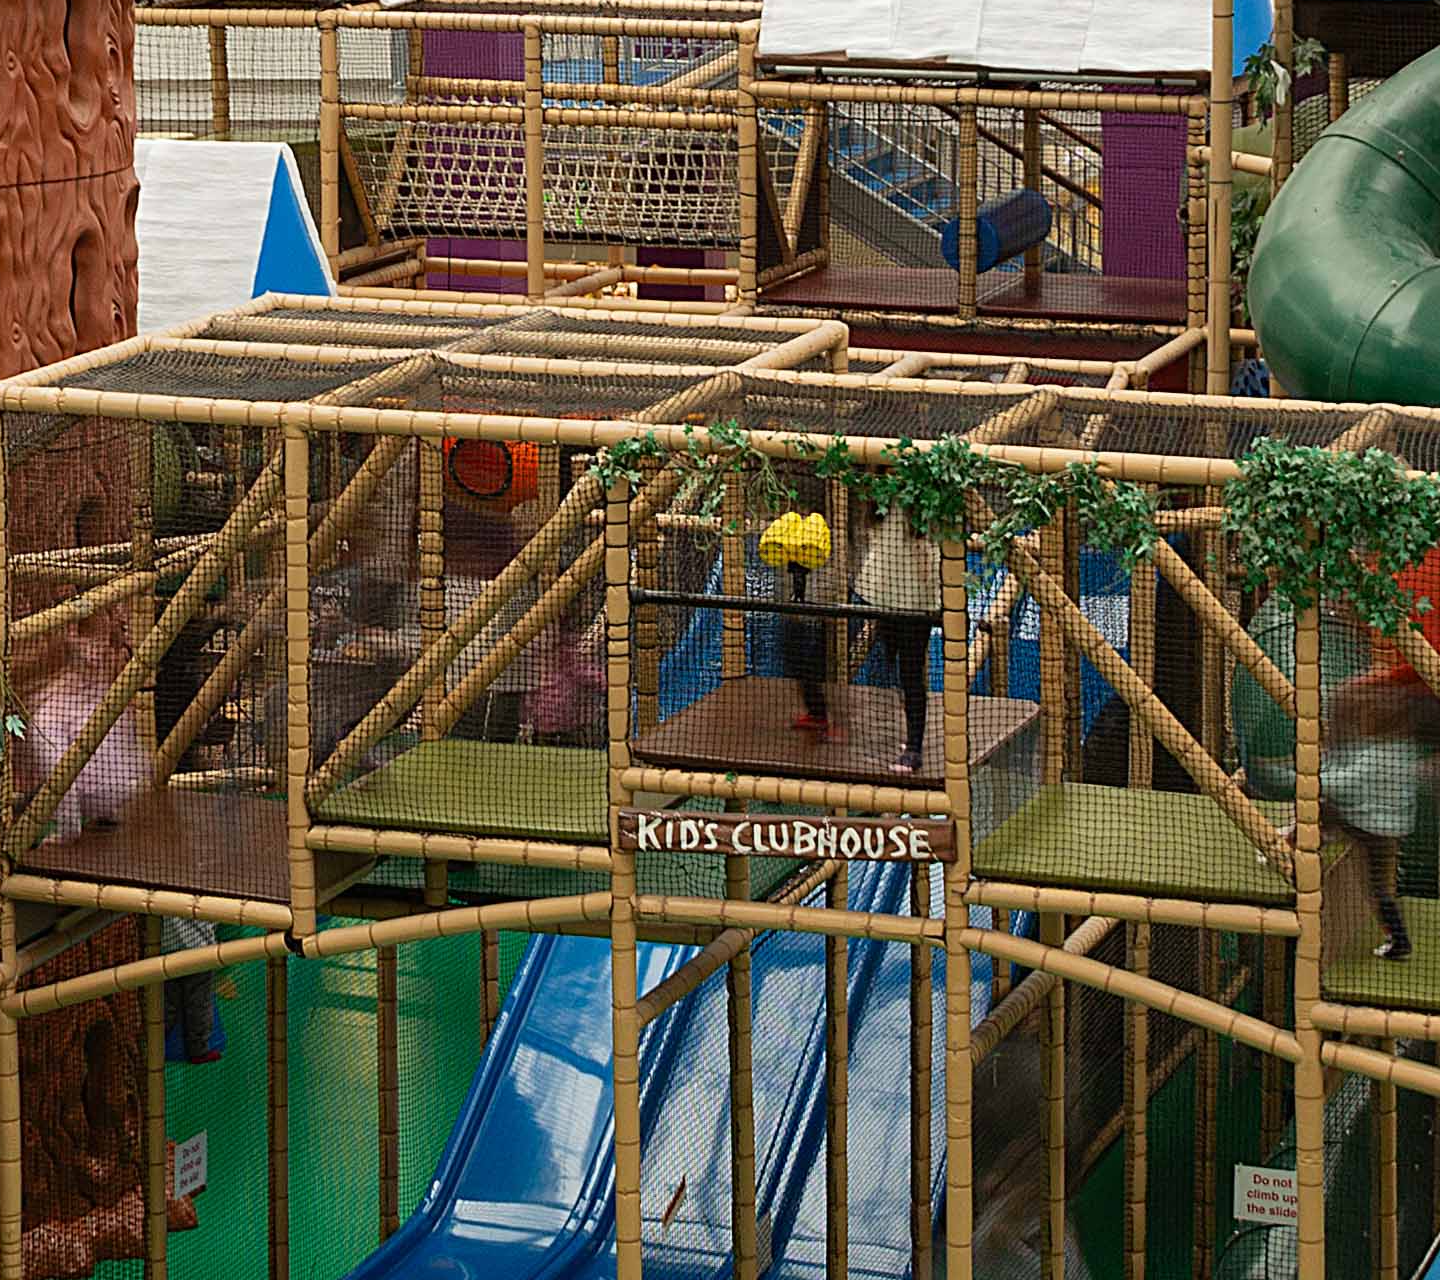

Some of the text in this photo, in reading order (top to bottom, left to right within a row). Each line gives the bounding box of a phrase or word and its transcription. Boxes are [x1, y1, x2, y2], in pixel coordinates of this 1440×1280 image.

[638, 813, 931, 860] KID'S CLUBHOUSE
[1253, 1174, 1292, 1188] Do not
[1247, 1189, 1279, 1201] climb
[1247, 1202, 1297, 1218] the slide
